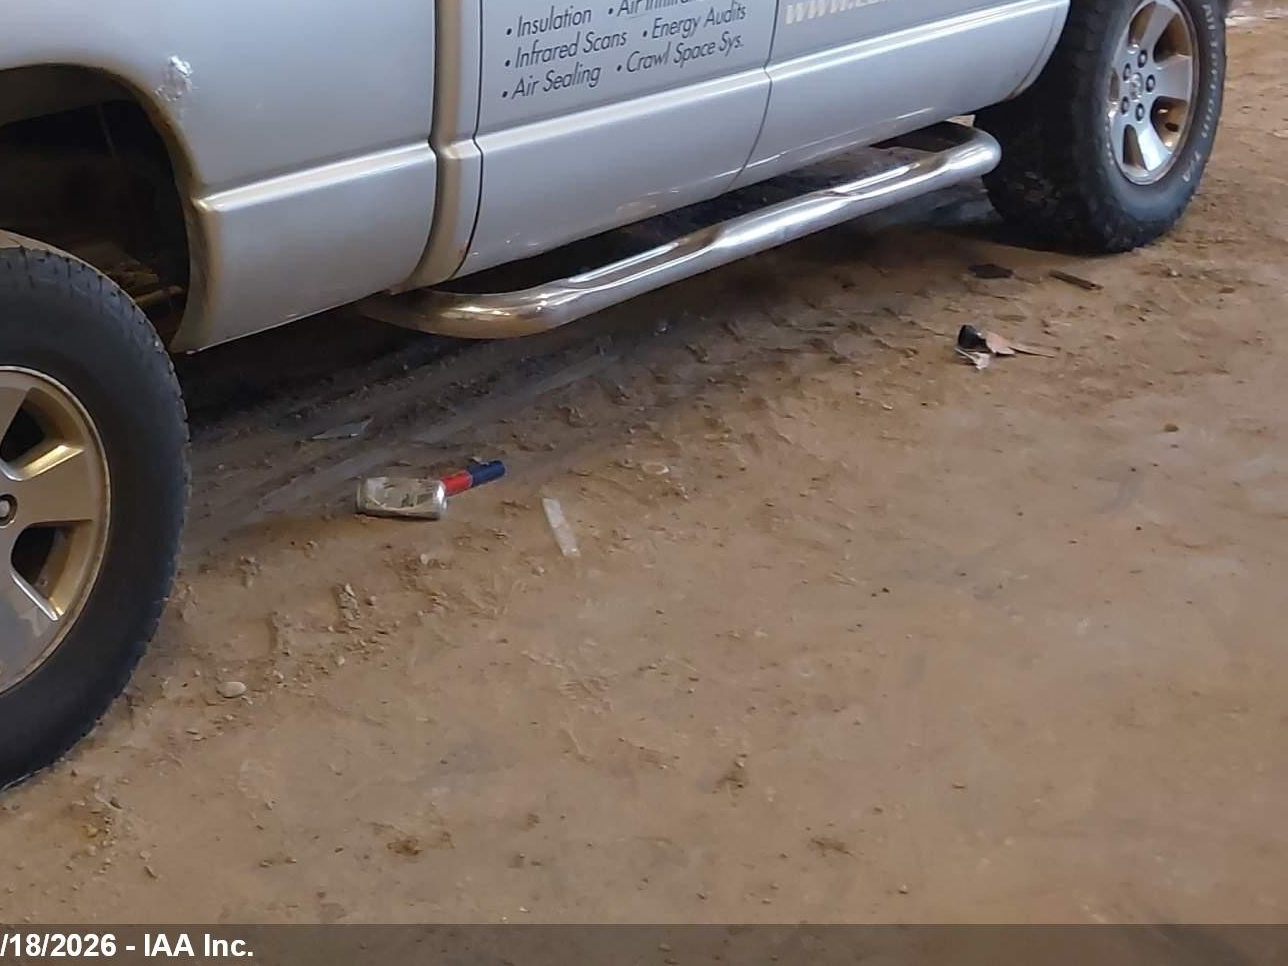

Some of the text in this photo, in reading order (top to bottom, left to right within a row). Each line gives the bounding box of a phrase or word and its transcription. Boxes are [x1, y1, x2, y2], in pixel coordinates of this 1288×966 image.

[517, 5, 592, 38] Insulation
[652, 0, 746, 40] Energy Audits
[515, 30, 628, 68] Infrared Scans
[626, 31, 745, 73] Crawl Space Sys.
[511, 61, 602, 99] Air Sealing
